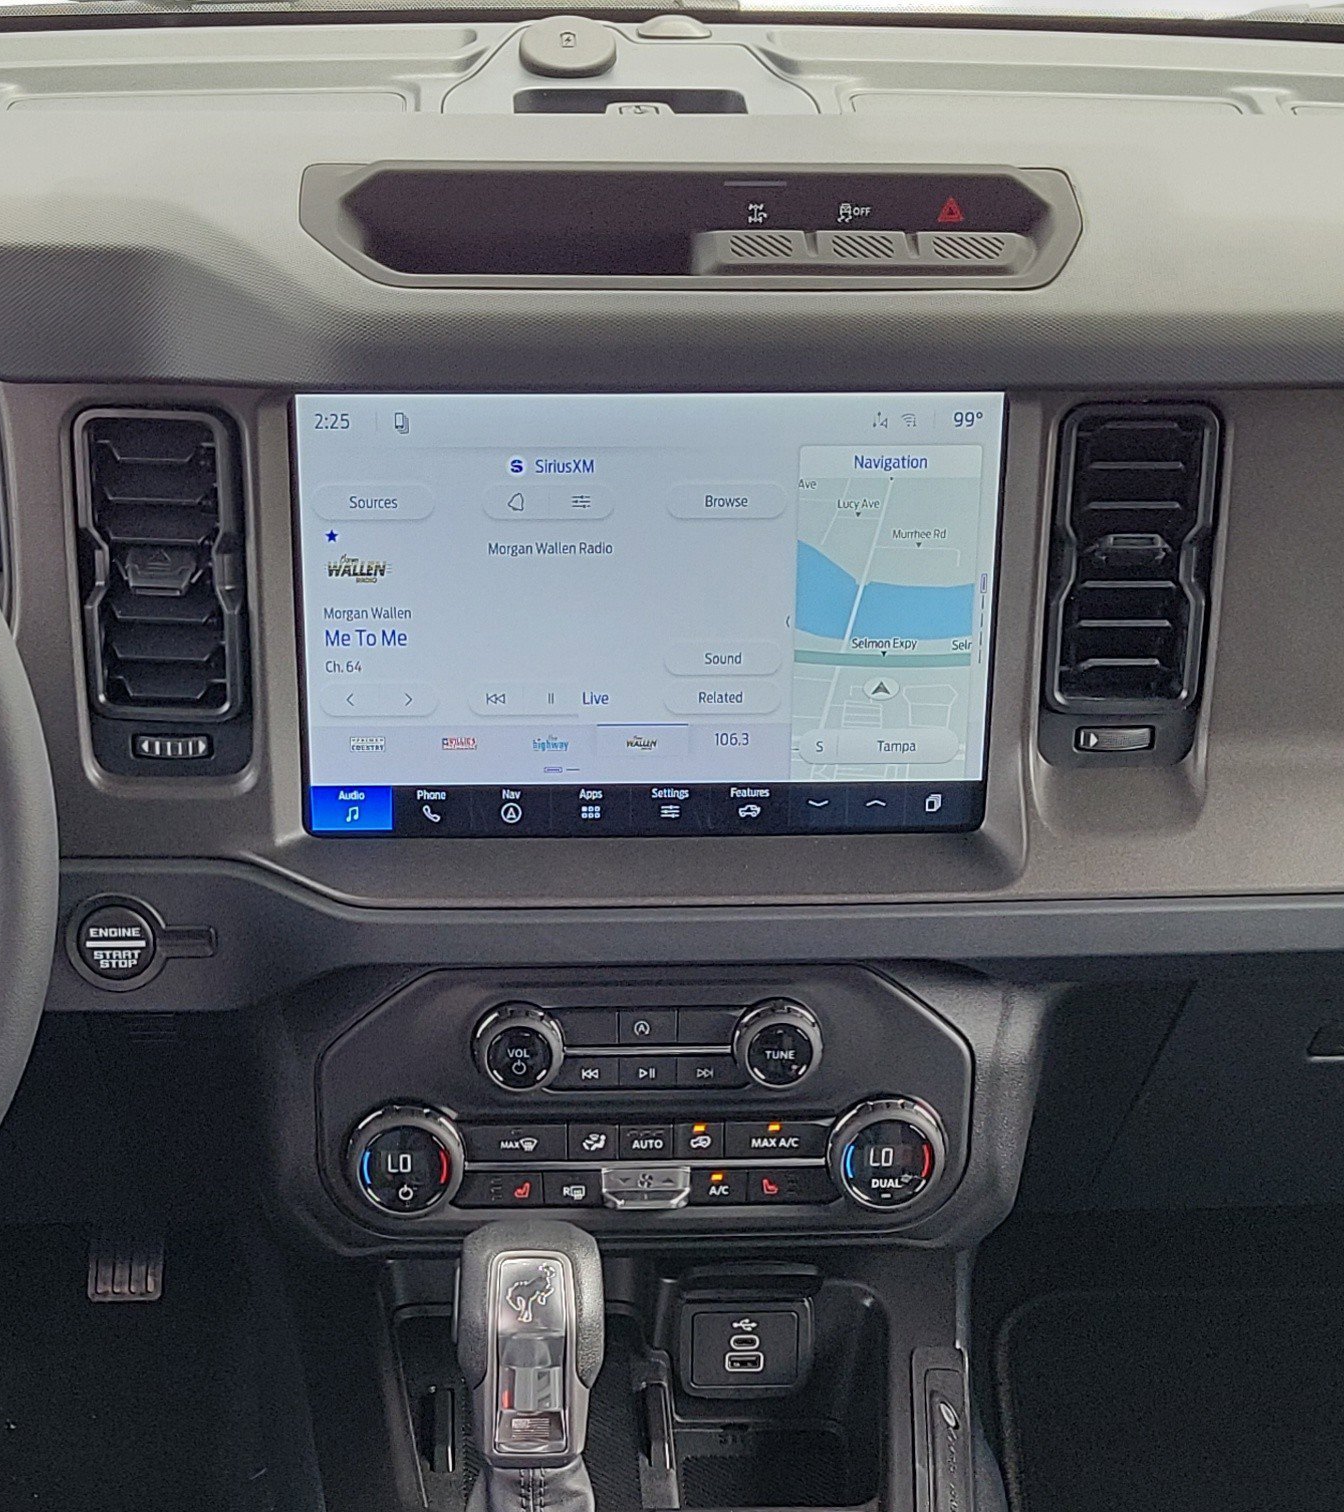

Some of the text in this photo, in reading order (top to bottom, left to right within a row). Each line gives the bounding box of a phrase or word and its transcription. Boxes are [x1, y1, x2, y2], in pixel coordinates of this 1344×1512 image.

[853, 206, 871, 217] OFF
[314, 413, 350, 430] 2:25
[535, 459, 595, 474] SiriusXM
[854, 454, 928, 471] Navigation
[798, 479, 817, 489] Ave
[349, 495, 398, 510] Sources
[705, 495, 748, 508] Browse
[837, 499, 880, 510] Lucy Ave
[933, 529, 946, 539] Rd
[488, 541, 613, 557] Morgan Wallen Radio
[328, 561, 386, 577] WALLEN
[323, 606, 412, 621] Morgan Wallen
[325, 629, 408, 647] Me To Me
[852, 637, 917, 651] Selmon Expy
[704, 653, 742, 666] Sound
[325, 660, 362, 674] Ch. 64
[582, 692, 609, 705] Live
[698, 691, 743, 705] Related
[714, 733, 750, 747] 106.3
[816, 741, 916, 754] S Tampa
[338, 789, 365, 801] Audio
[416, 789, 446, 801] Phone
[502, 789, 521, 800] Nav
[579, 788, 603, 802] Apps
[651, 787, 689, 800] Settings
[730, 787, 770, 799] Features
[89, 928, 141, 938] ENGINE
[93, 950, 141, 960] START
[99, 960, 138, 968] STOP
[507, 1049, 530, 1058] VOL
[765, 1050, 795, 1060] TUNE
[500, 1141, 519, 1149] MAX
[632, 1139, 663, 1149] AUTO
[751, 1137, 799, 1148] MAX A/C
[388, 1153, 412, 1173] LO
[870, 1147, 894, 1167] LO
[871, 1178, 902, 1188] DUAL
[709, 1186, 729, 1196] A/C
